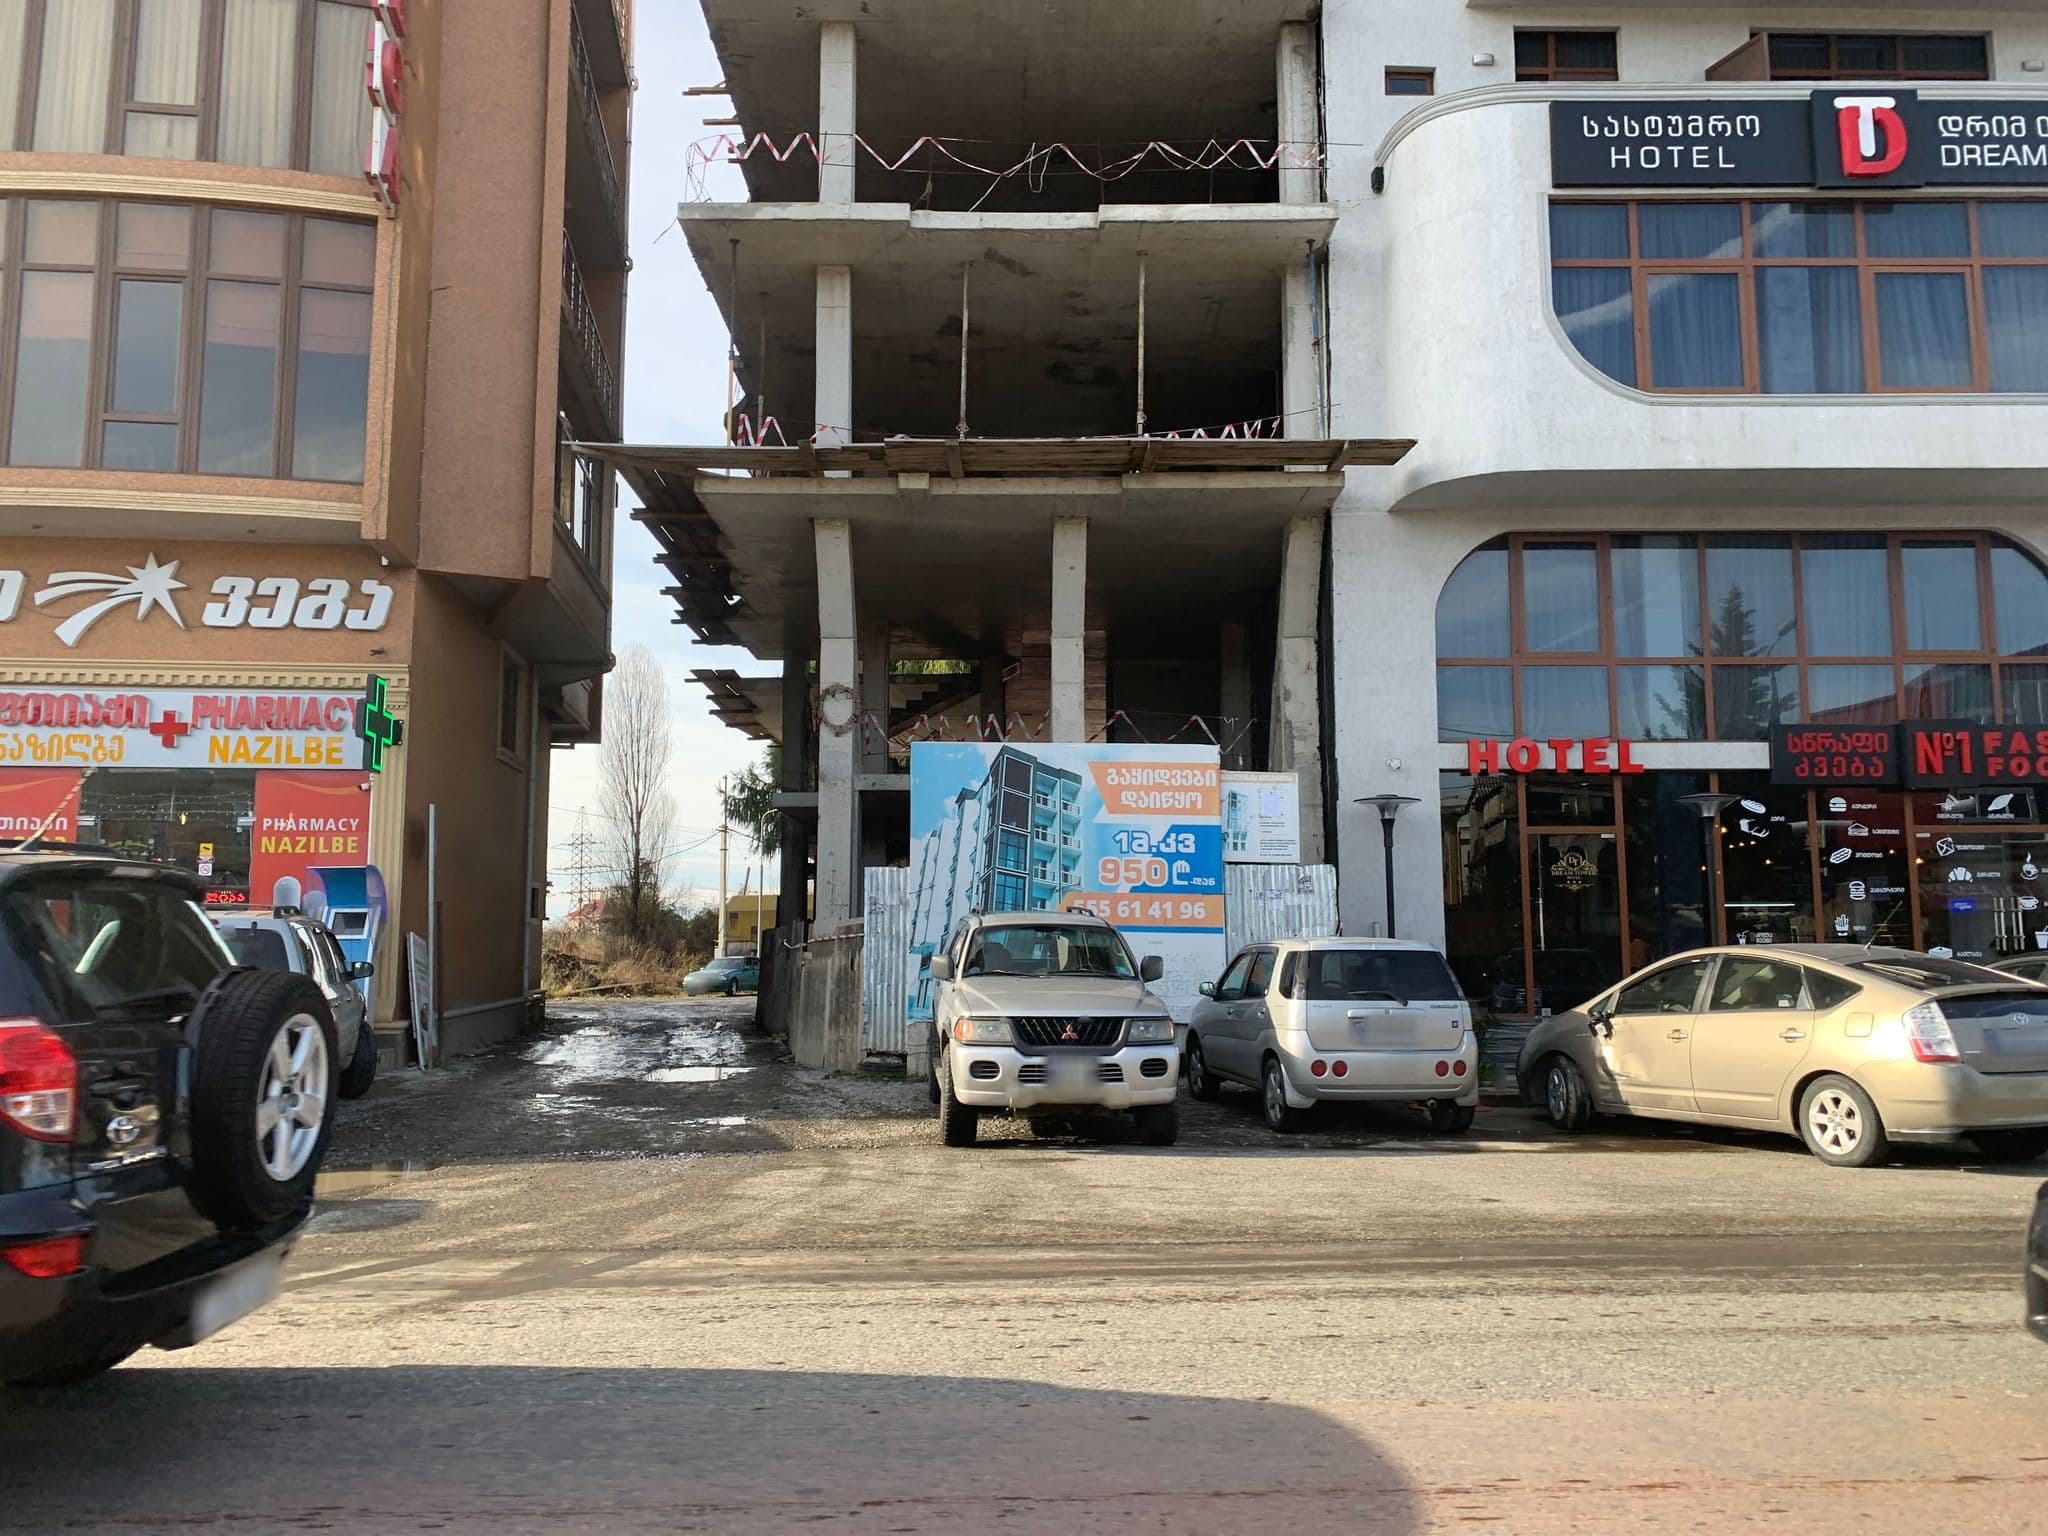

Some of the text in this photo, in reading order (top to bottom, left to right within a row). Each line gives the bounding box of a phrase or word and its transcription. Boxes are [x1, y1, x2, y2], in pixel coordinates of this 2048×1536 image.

[1582, 115, 1760, 137] სასტუმრო
[1938, 115, 2026, 138] დრიმ
[1610, 146, 1736, 168] HOTEL
[1941, 144, 2048, 167] DREAM
[201, 576, 394, 630] ვეგა
[208, 735, 344, 764] NAZILBE
[1787, 732, 1889, 753] სწრაფი
[1467, 737, 1646, 774] HOTEL
[1106, 767, 1217, 787] გაყიდვები
[1795, 756, 1884, 777] კვება
[1121, 791, 1203, 809] დაიწყო
[262, 818, 360, 831] PHARMACY
[260, 836, 359, 854] NAZILBE
[1116, 900, 1141, 918] 61
[1148, 901, 1173, 919] 41
[1180, 902, 1206, 919] 96
